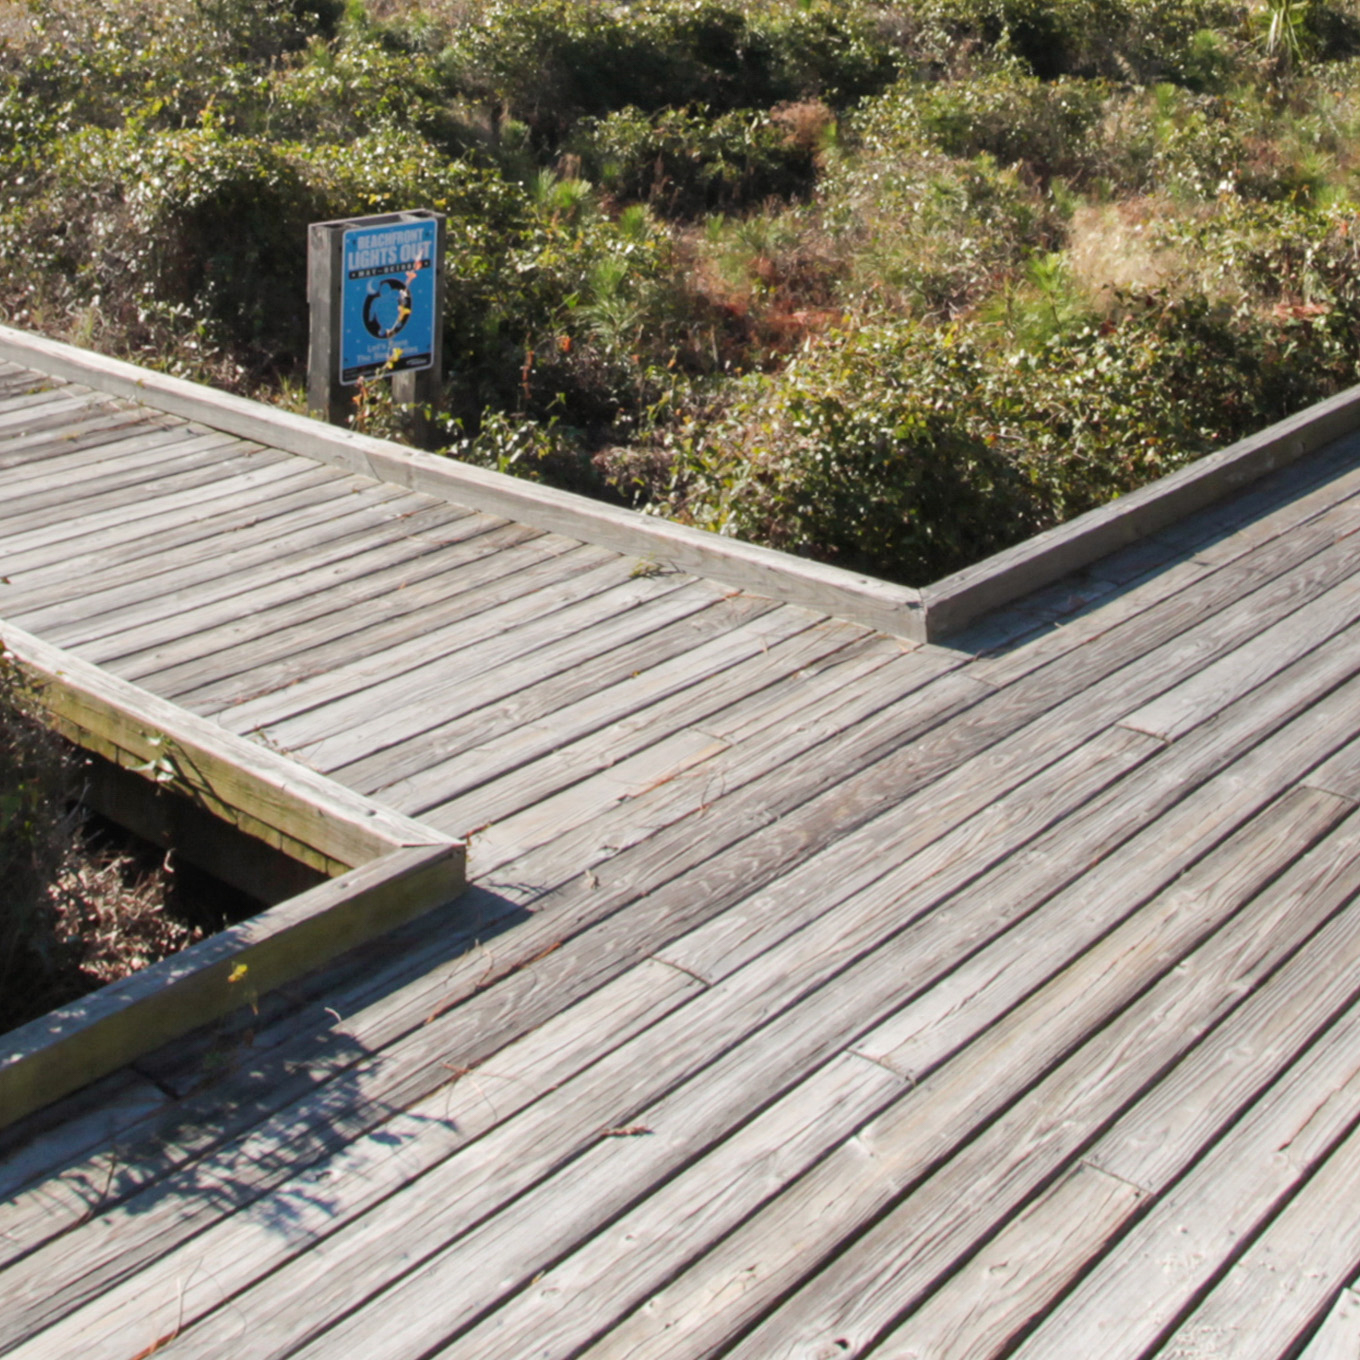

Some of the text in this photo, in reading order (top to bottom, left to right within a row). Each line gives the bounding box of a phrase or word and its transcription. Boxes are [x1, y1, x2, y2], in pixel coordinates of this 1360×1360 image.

[357, 228, 424, 249] BEACHFRONT
[348, 241, 432, 271] LIGHTS OUT
